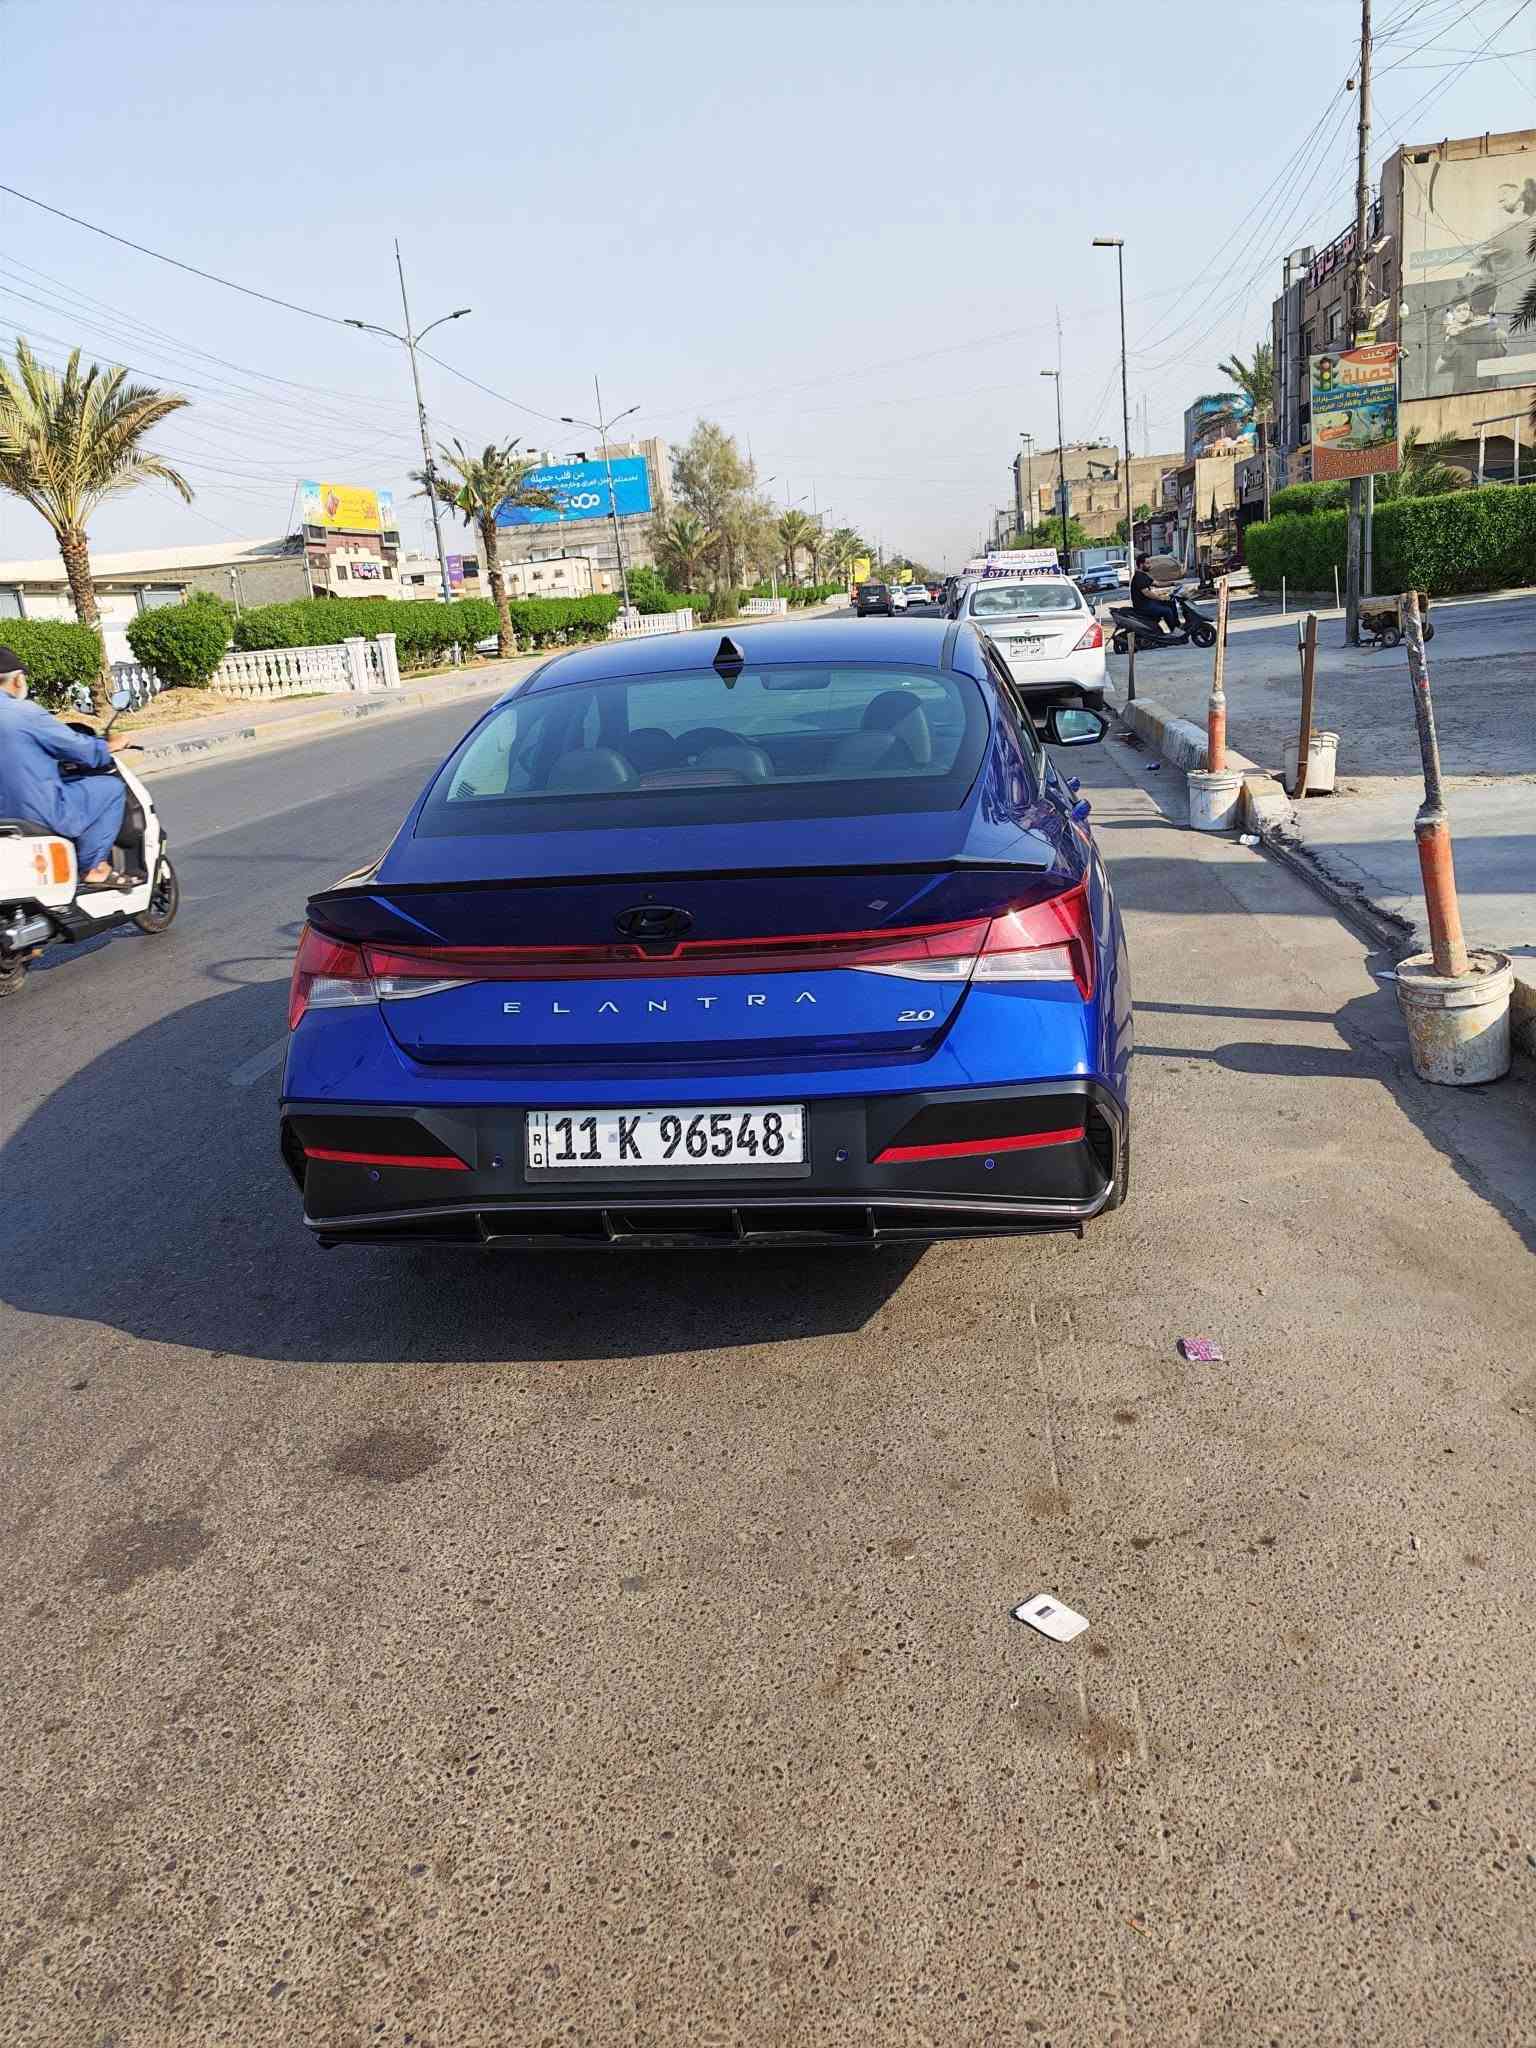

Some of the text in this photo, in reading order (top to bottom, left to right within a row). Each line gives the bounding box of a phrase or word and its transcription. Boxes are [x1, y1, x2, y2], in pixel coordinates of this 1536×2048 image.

[554, 1112, 785, 1161] 11 K 96548
